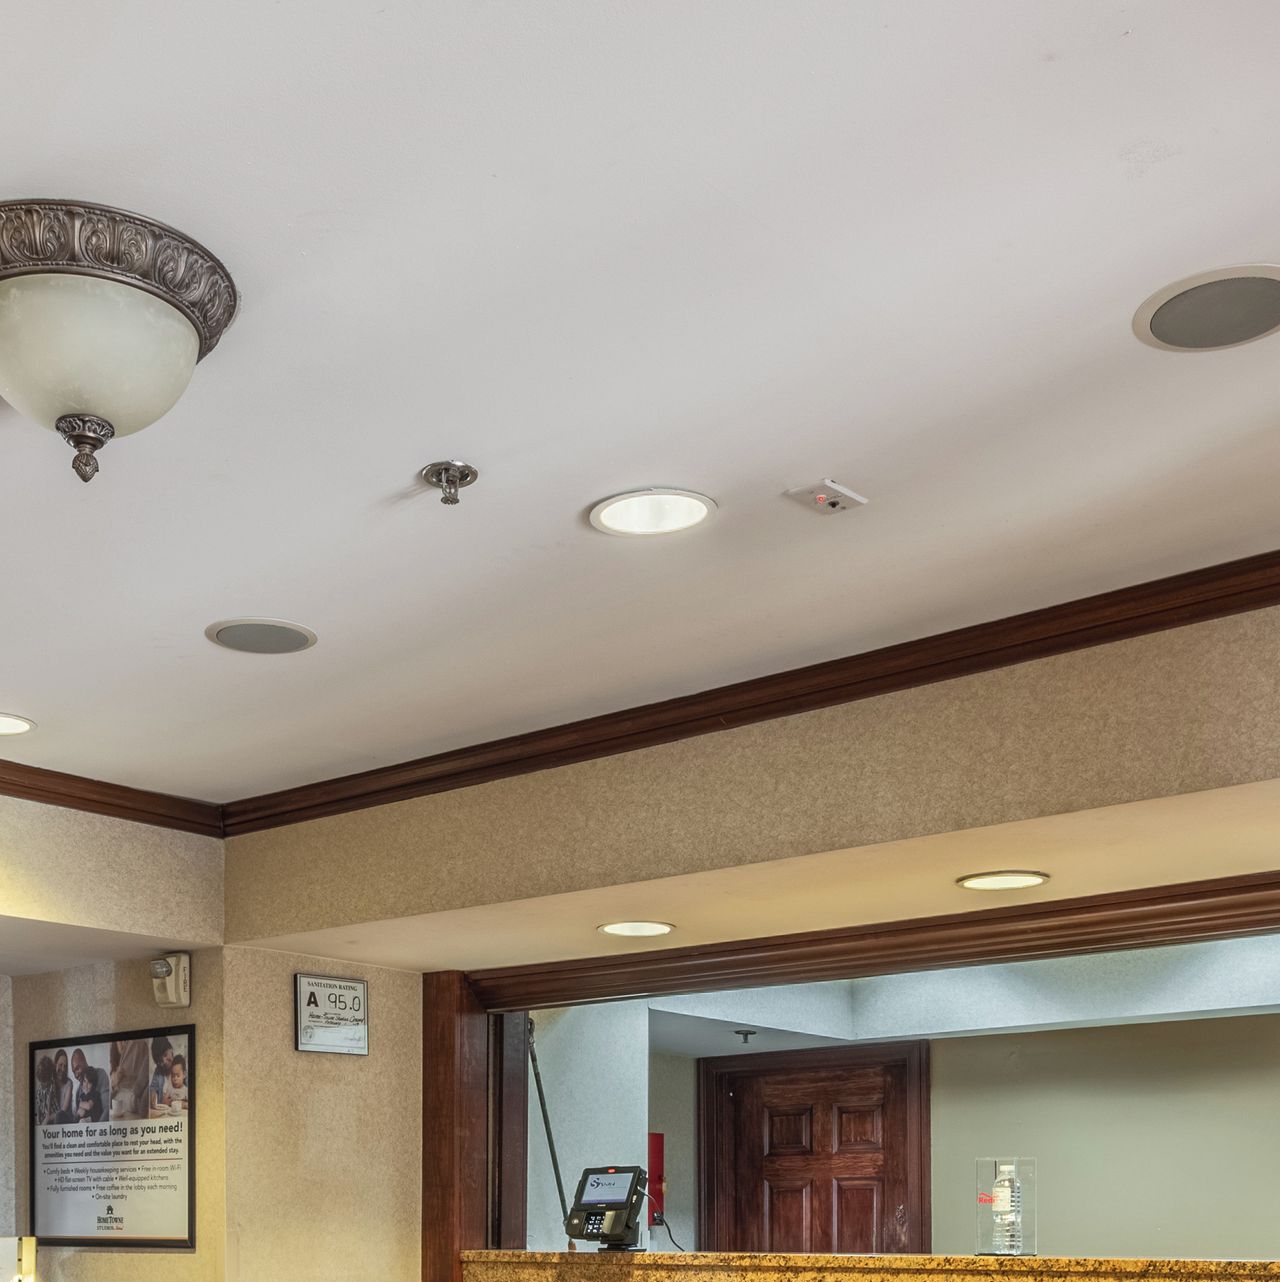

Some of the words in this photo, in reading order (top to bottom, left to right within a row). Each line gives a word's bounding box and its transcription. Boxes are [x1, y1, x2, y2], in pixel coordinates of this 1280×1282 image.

[308, 981, 337, 989] SANITATION
[306, 991, 319, 1007] A
[328, 993, 361, 1012] 95.0
[43, 1129, 59, 1139] Your
[62, 1128, 83, 1138] home
[86, 1126, 97, 1137] for
[99, 1128, 107, 1136] as
[109, 1125, 127, 1138] long
[130, 1126, 138, 1135] as
[141, 1126, 156, 1137] you
[159, 1121, 183, 1133] need!
[112, 1140, 123, 1148] place
[139, 1139, 149, 1147] your
